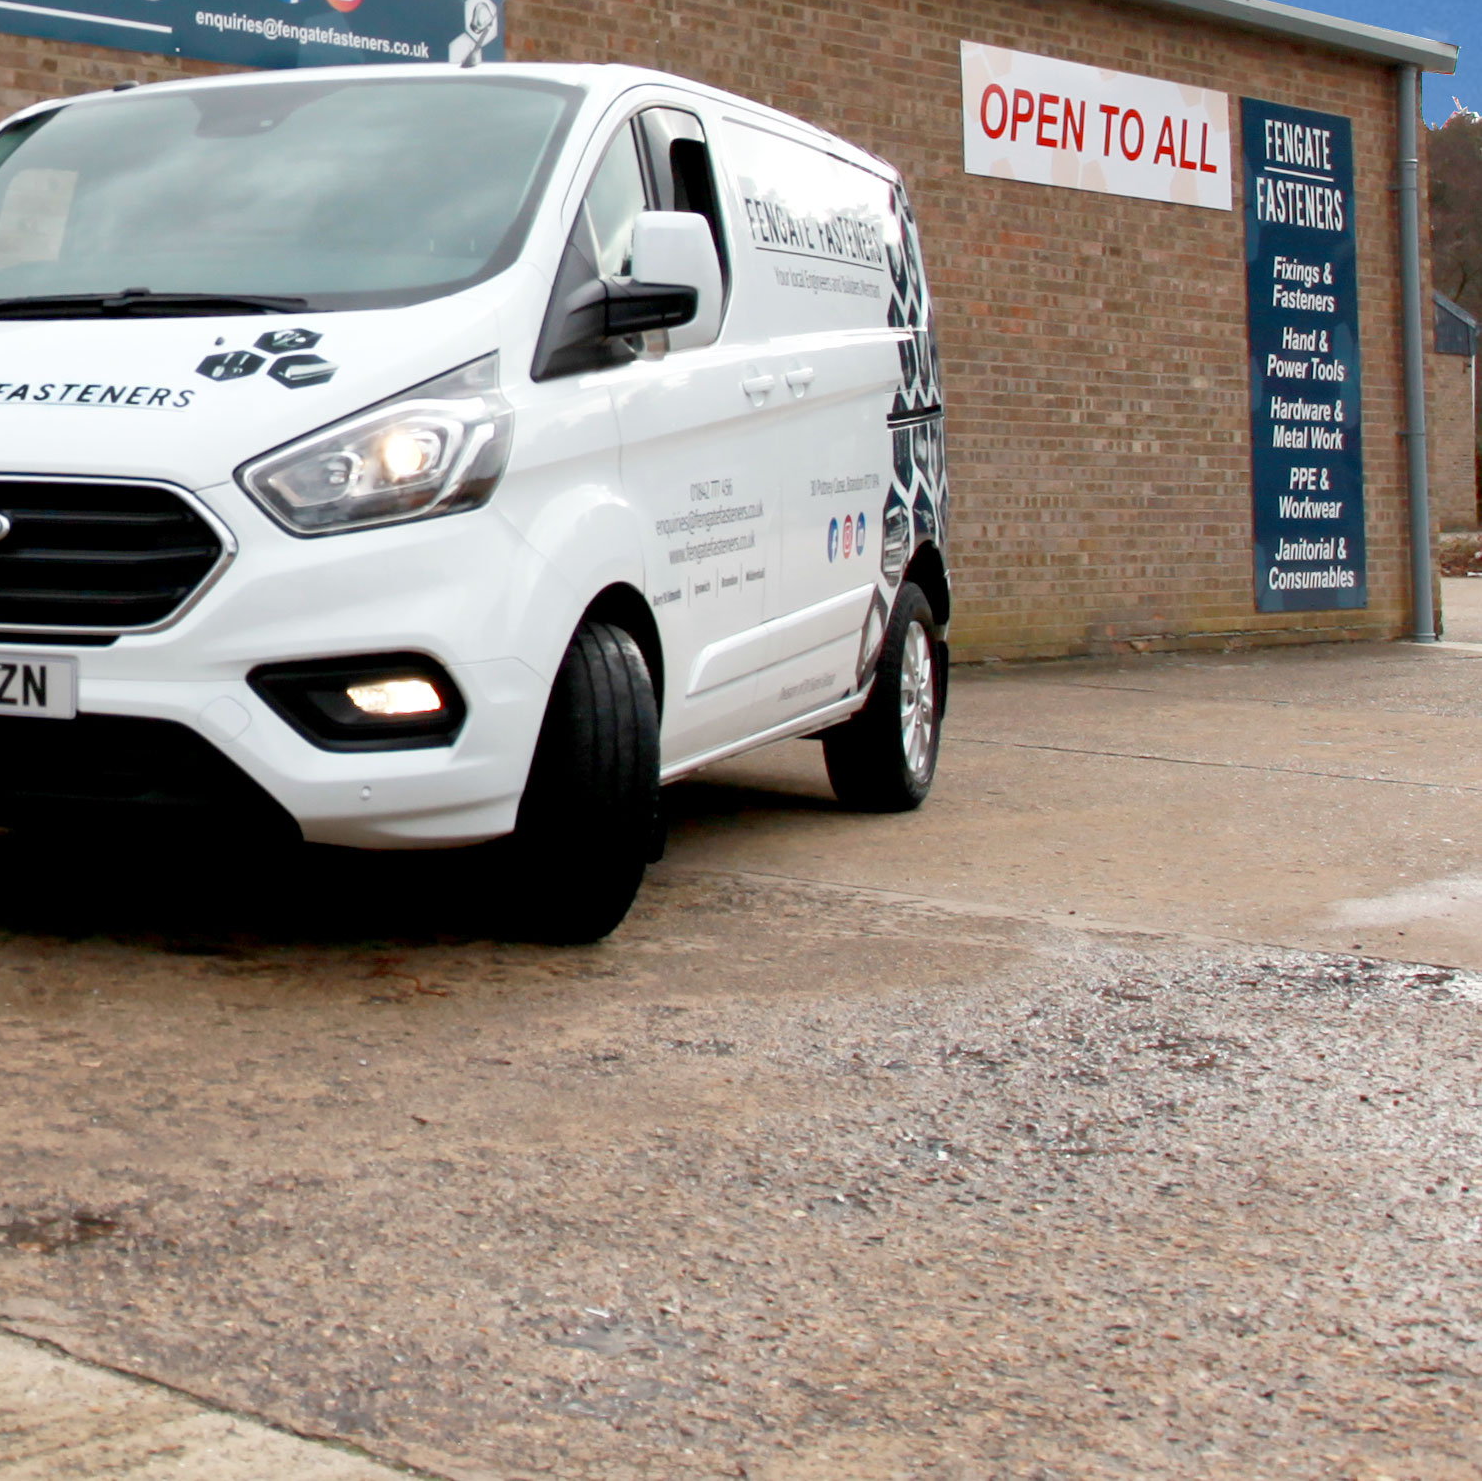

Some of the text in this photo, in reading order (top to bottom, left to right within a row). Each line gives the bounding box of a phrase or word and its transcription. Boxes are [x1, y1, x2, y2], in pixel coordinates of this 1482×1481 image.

[195, 11, 430, 59] enquiries@fengatefasteners.co.uk
[980, 83, 1218, 174] OPEN TO ALL
[1264, 118, 1332, 170] FENGATE
[1256, 177, 1344, 233] FASTENERS
[745, 198, 883, 263] FENGATE FASTENERS
[1272, 256, 1333, 286] Fixings &
[1272, 284, 1335, 313] Fasteners
[1282, 327, 1329, 353] Hand &
[1267, 356, 1345, 382] Power Tools
[1270, 397, 1344, 422] Hardware &
[1272, 426, 1343, 450] Metal Work
[1290, 467, 1330, 491] PPE &
[1278, 497, 1342, 519] Workwear
[1275, 537, 1347, 561] Janitorial &
[1269, 565, 1354, 590] Consumables
